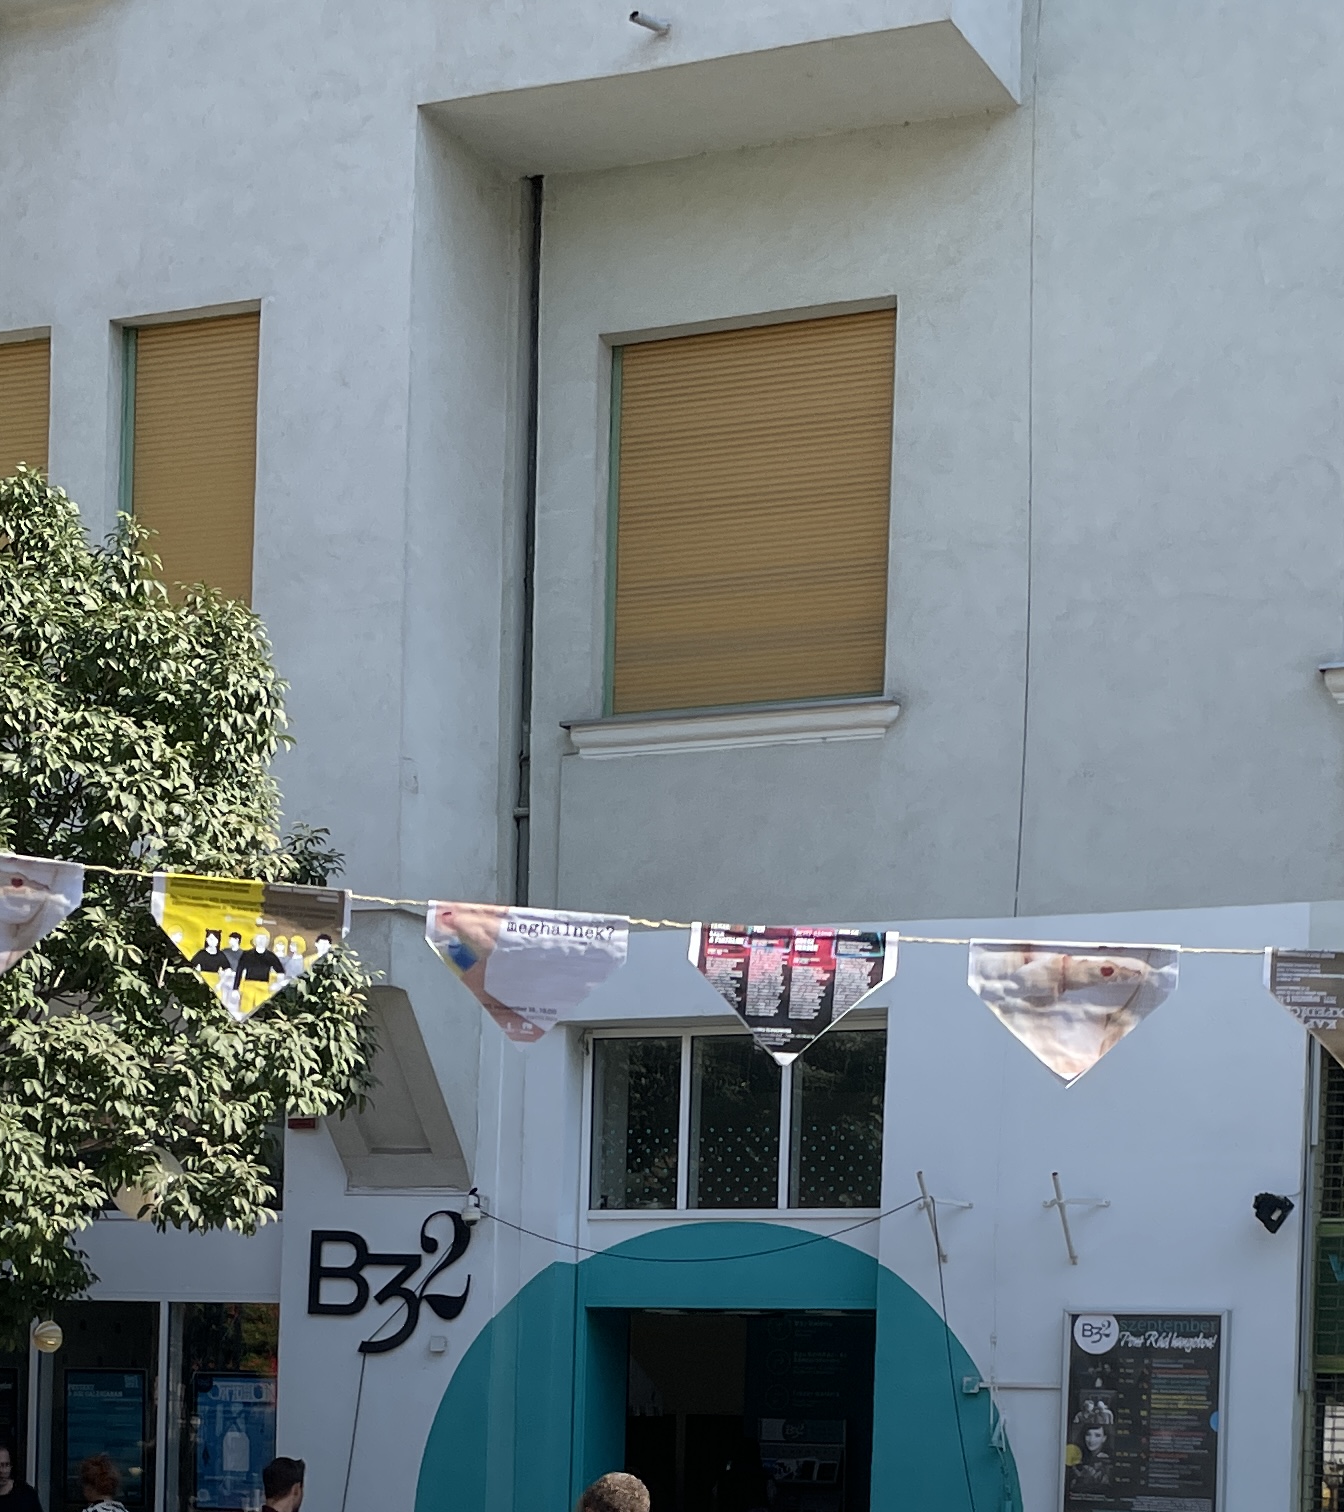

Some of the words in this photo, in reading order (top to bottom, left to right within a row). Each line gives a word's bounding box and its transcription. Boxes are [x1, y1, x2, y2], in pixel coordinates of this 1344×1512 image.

[308, 1210, 471, 1353] B32
[1081, 1319, 1112, 1344] B32
[1119, 1318, 1217, 1333] szeptember
